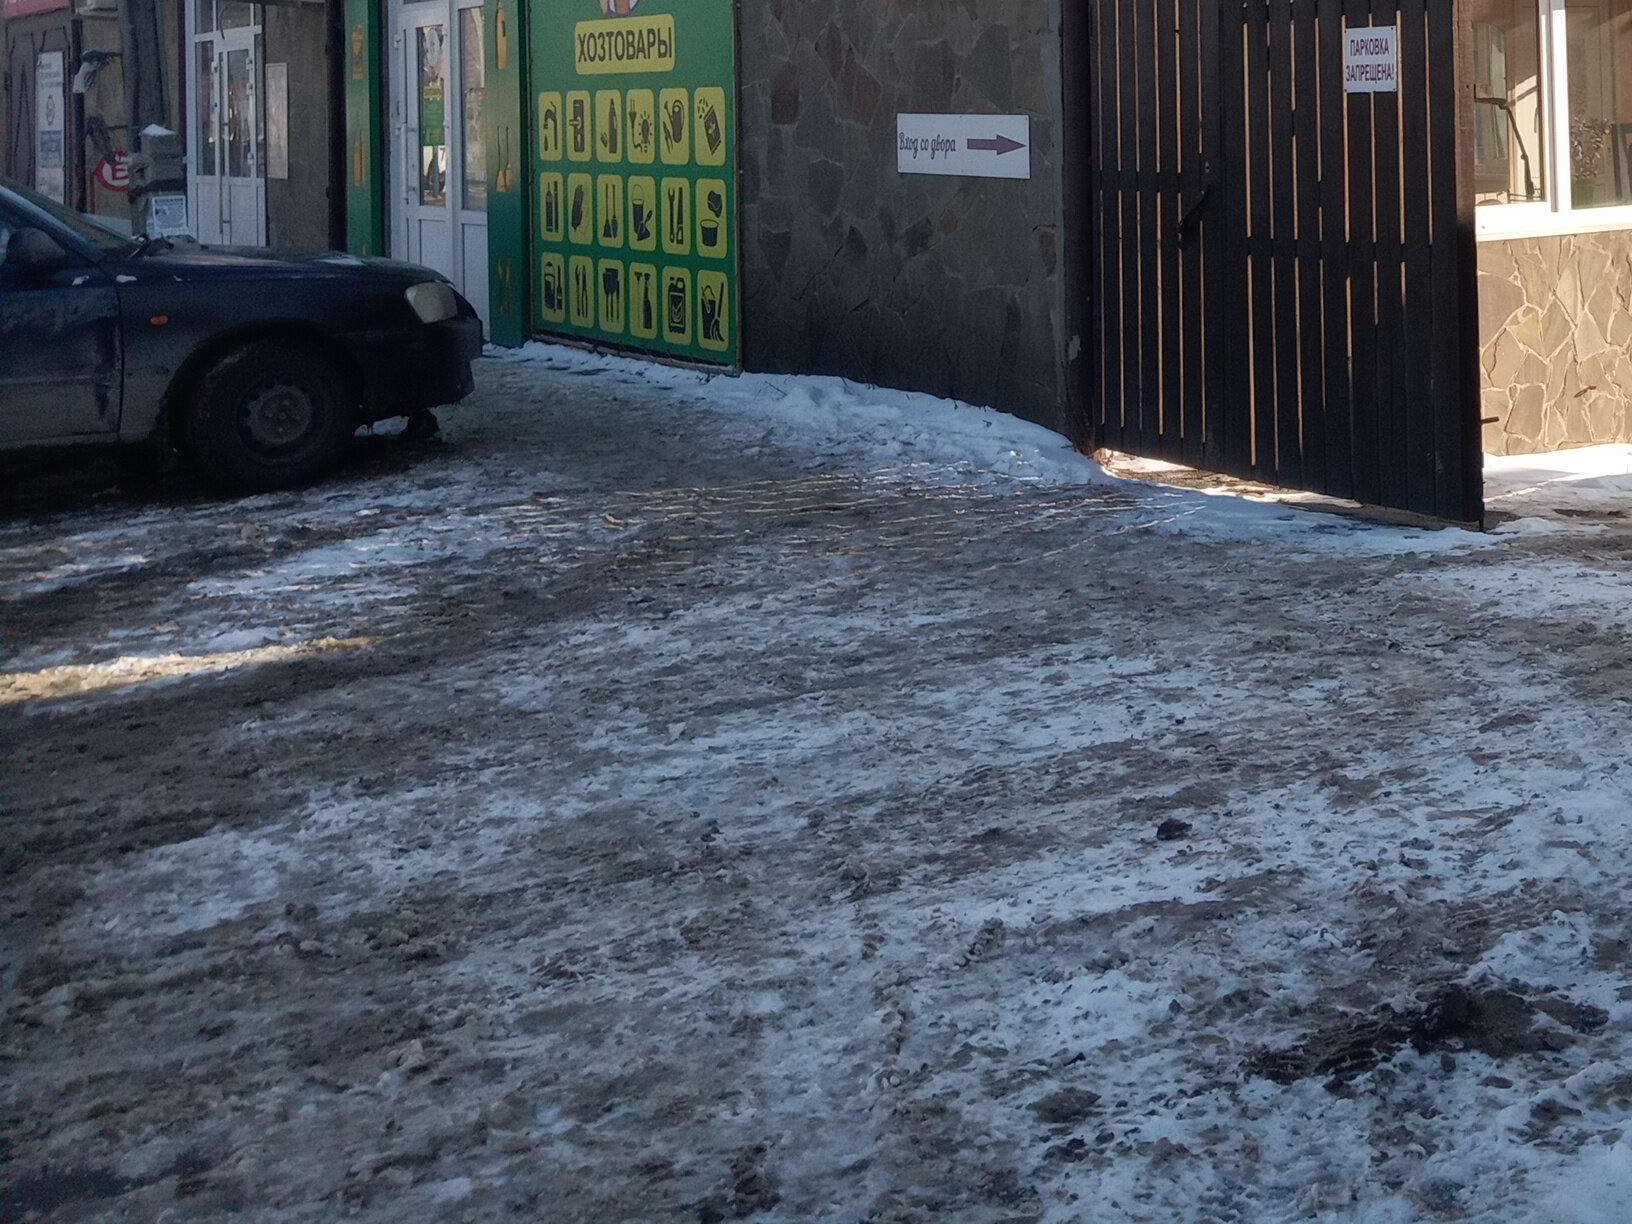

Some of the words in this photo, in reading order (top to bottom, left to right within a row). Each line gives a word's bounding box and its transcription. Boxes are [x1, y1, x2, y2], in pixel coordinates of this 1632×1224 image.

[577, 26, 673, 63] ХОЗТОВАРЫ
[1350, 37, 1390, 57] ПАРКОВКА
[1345, 63, 1394, 84] ЗАПРЕЩЕНА!
[899, 132, 918, 160] Вход
[920, 138, 929, 151] со
[930, 134, 956, 160] двора
